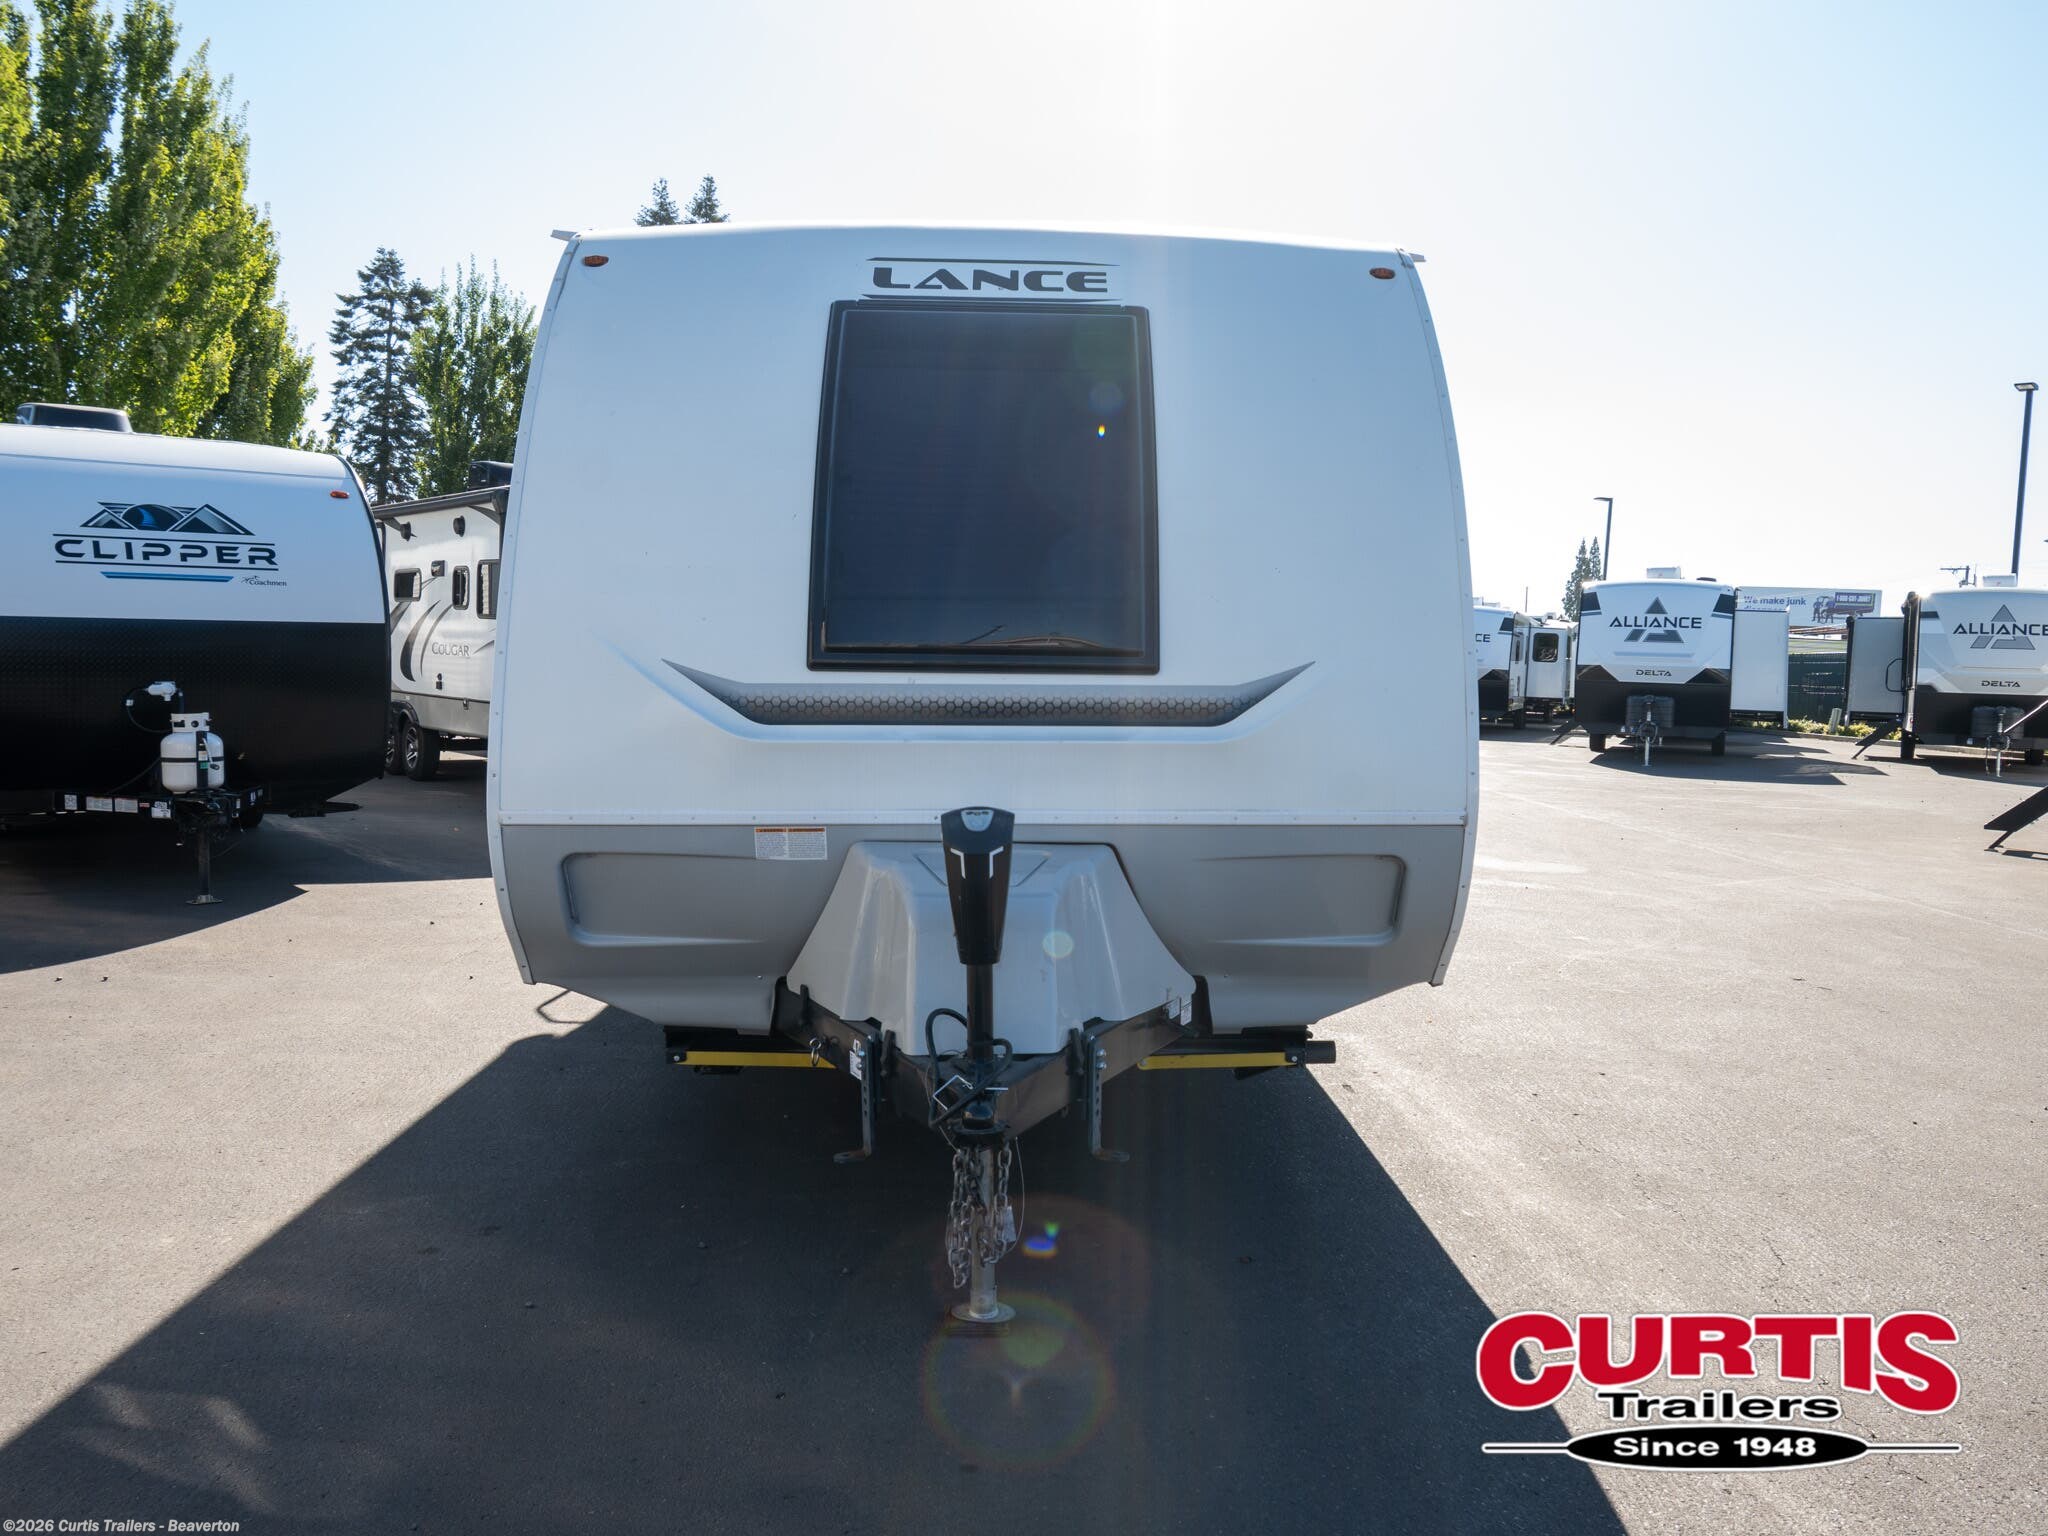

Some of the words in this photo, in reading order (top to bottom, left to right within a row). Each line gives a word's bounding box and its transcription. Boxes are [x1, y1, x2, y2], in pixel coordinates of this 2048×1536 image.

[872, 266, 1108, 293] LANCE
[54, 538, 279, 567] CLIPPER
[248, 578, 288, 587] Coachmen
[1760, 596, 1785, 605] make
[1786, 596, 1807, 607] junk
[1608, 615, 1703, 629] ALLIANCE
[431, 641, 470, 657] COUGAR
[1635, 669, 1672, 677] DELTA
[1981, 680, 2021, 688] DELTA
